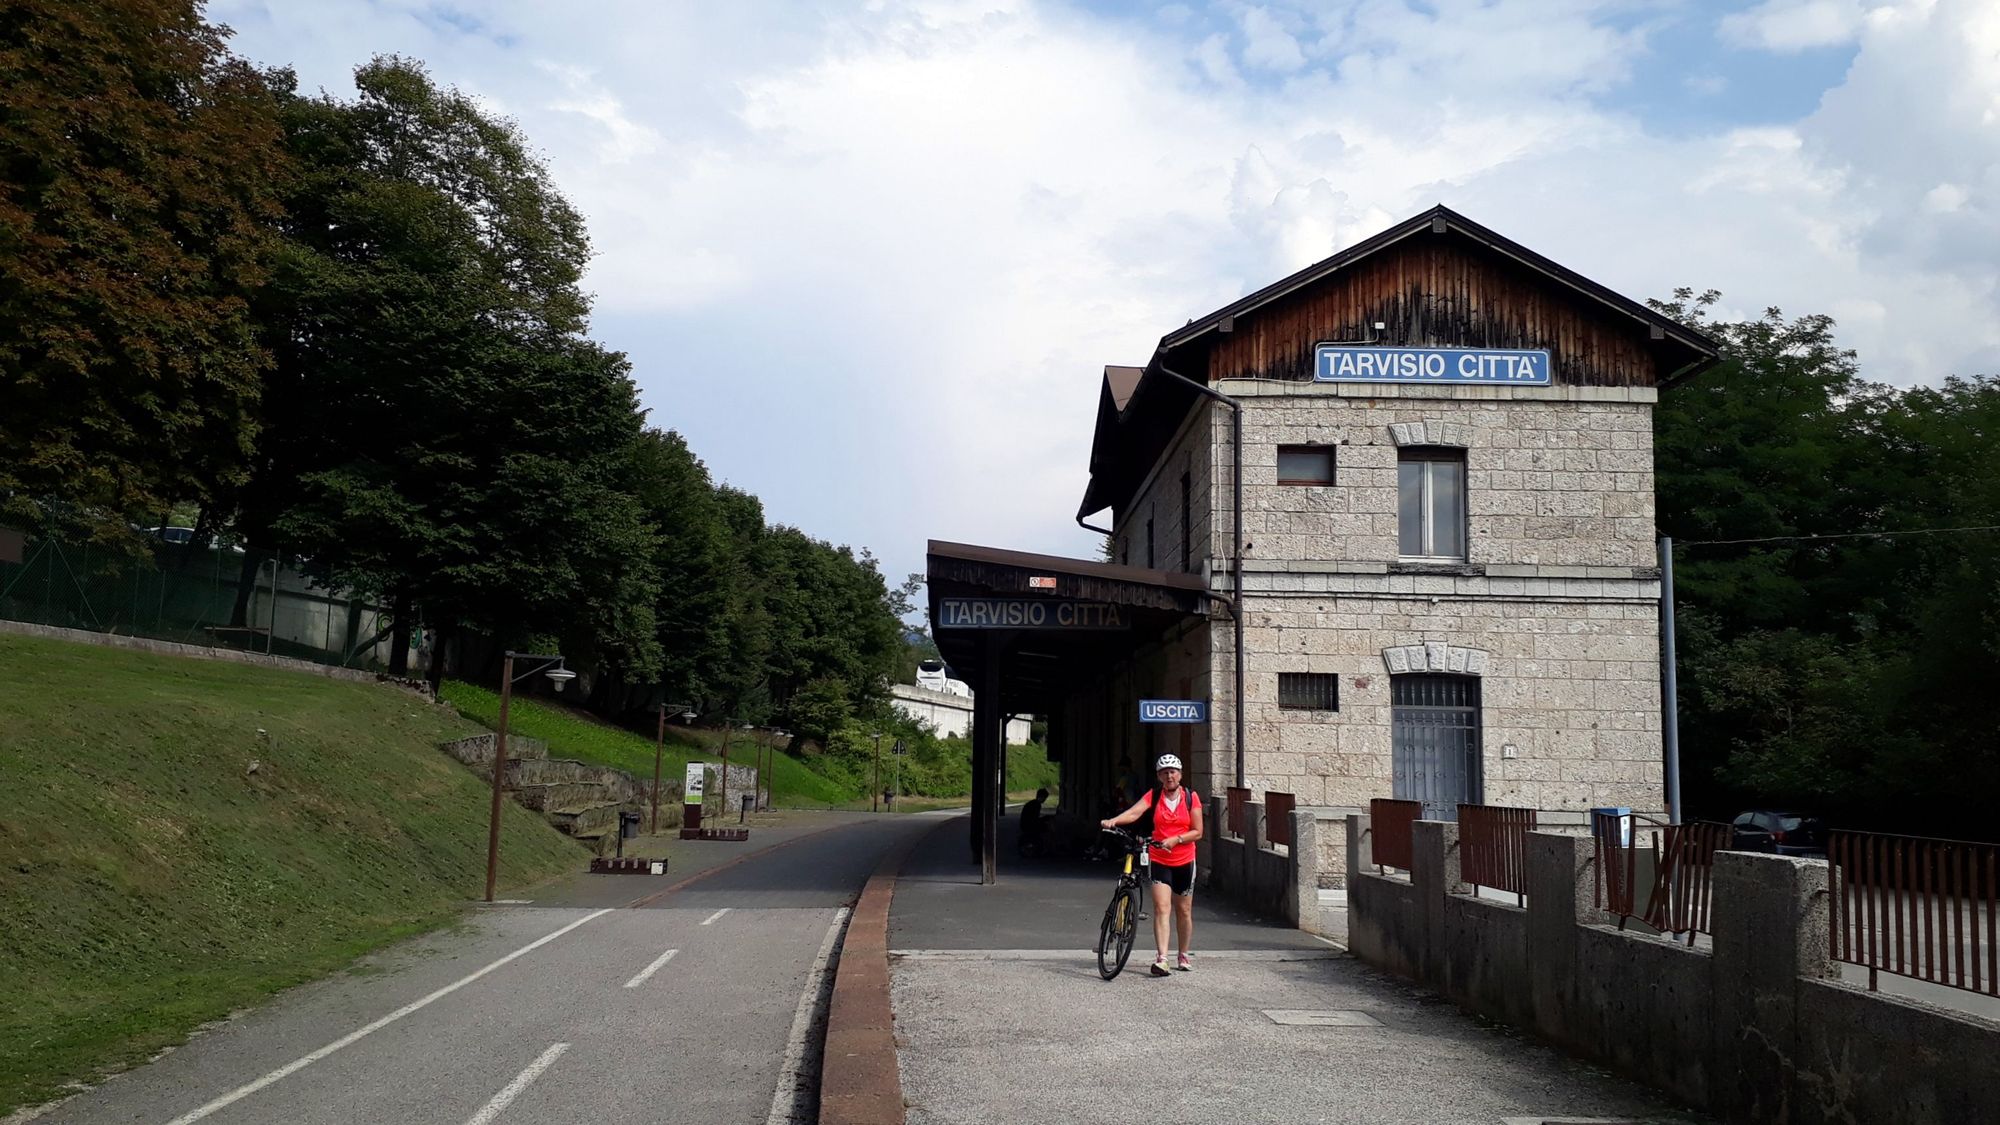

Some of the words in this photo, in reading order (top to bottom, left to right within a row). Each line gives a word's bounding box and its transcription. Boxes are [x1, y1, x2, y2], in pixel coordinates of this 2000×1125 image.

[1323, 352, 1446, 377] TARVISIO
[945, 601, 1046, 626] TARVISIO
[1146, 705, 1199, 719] USCITA
